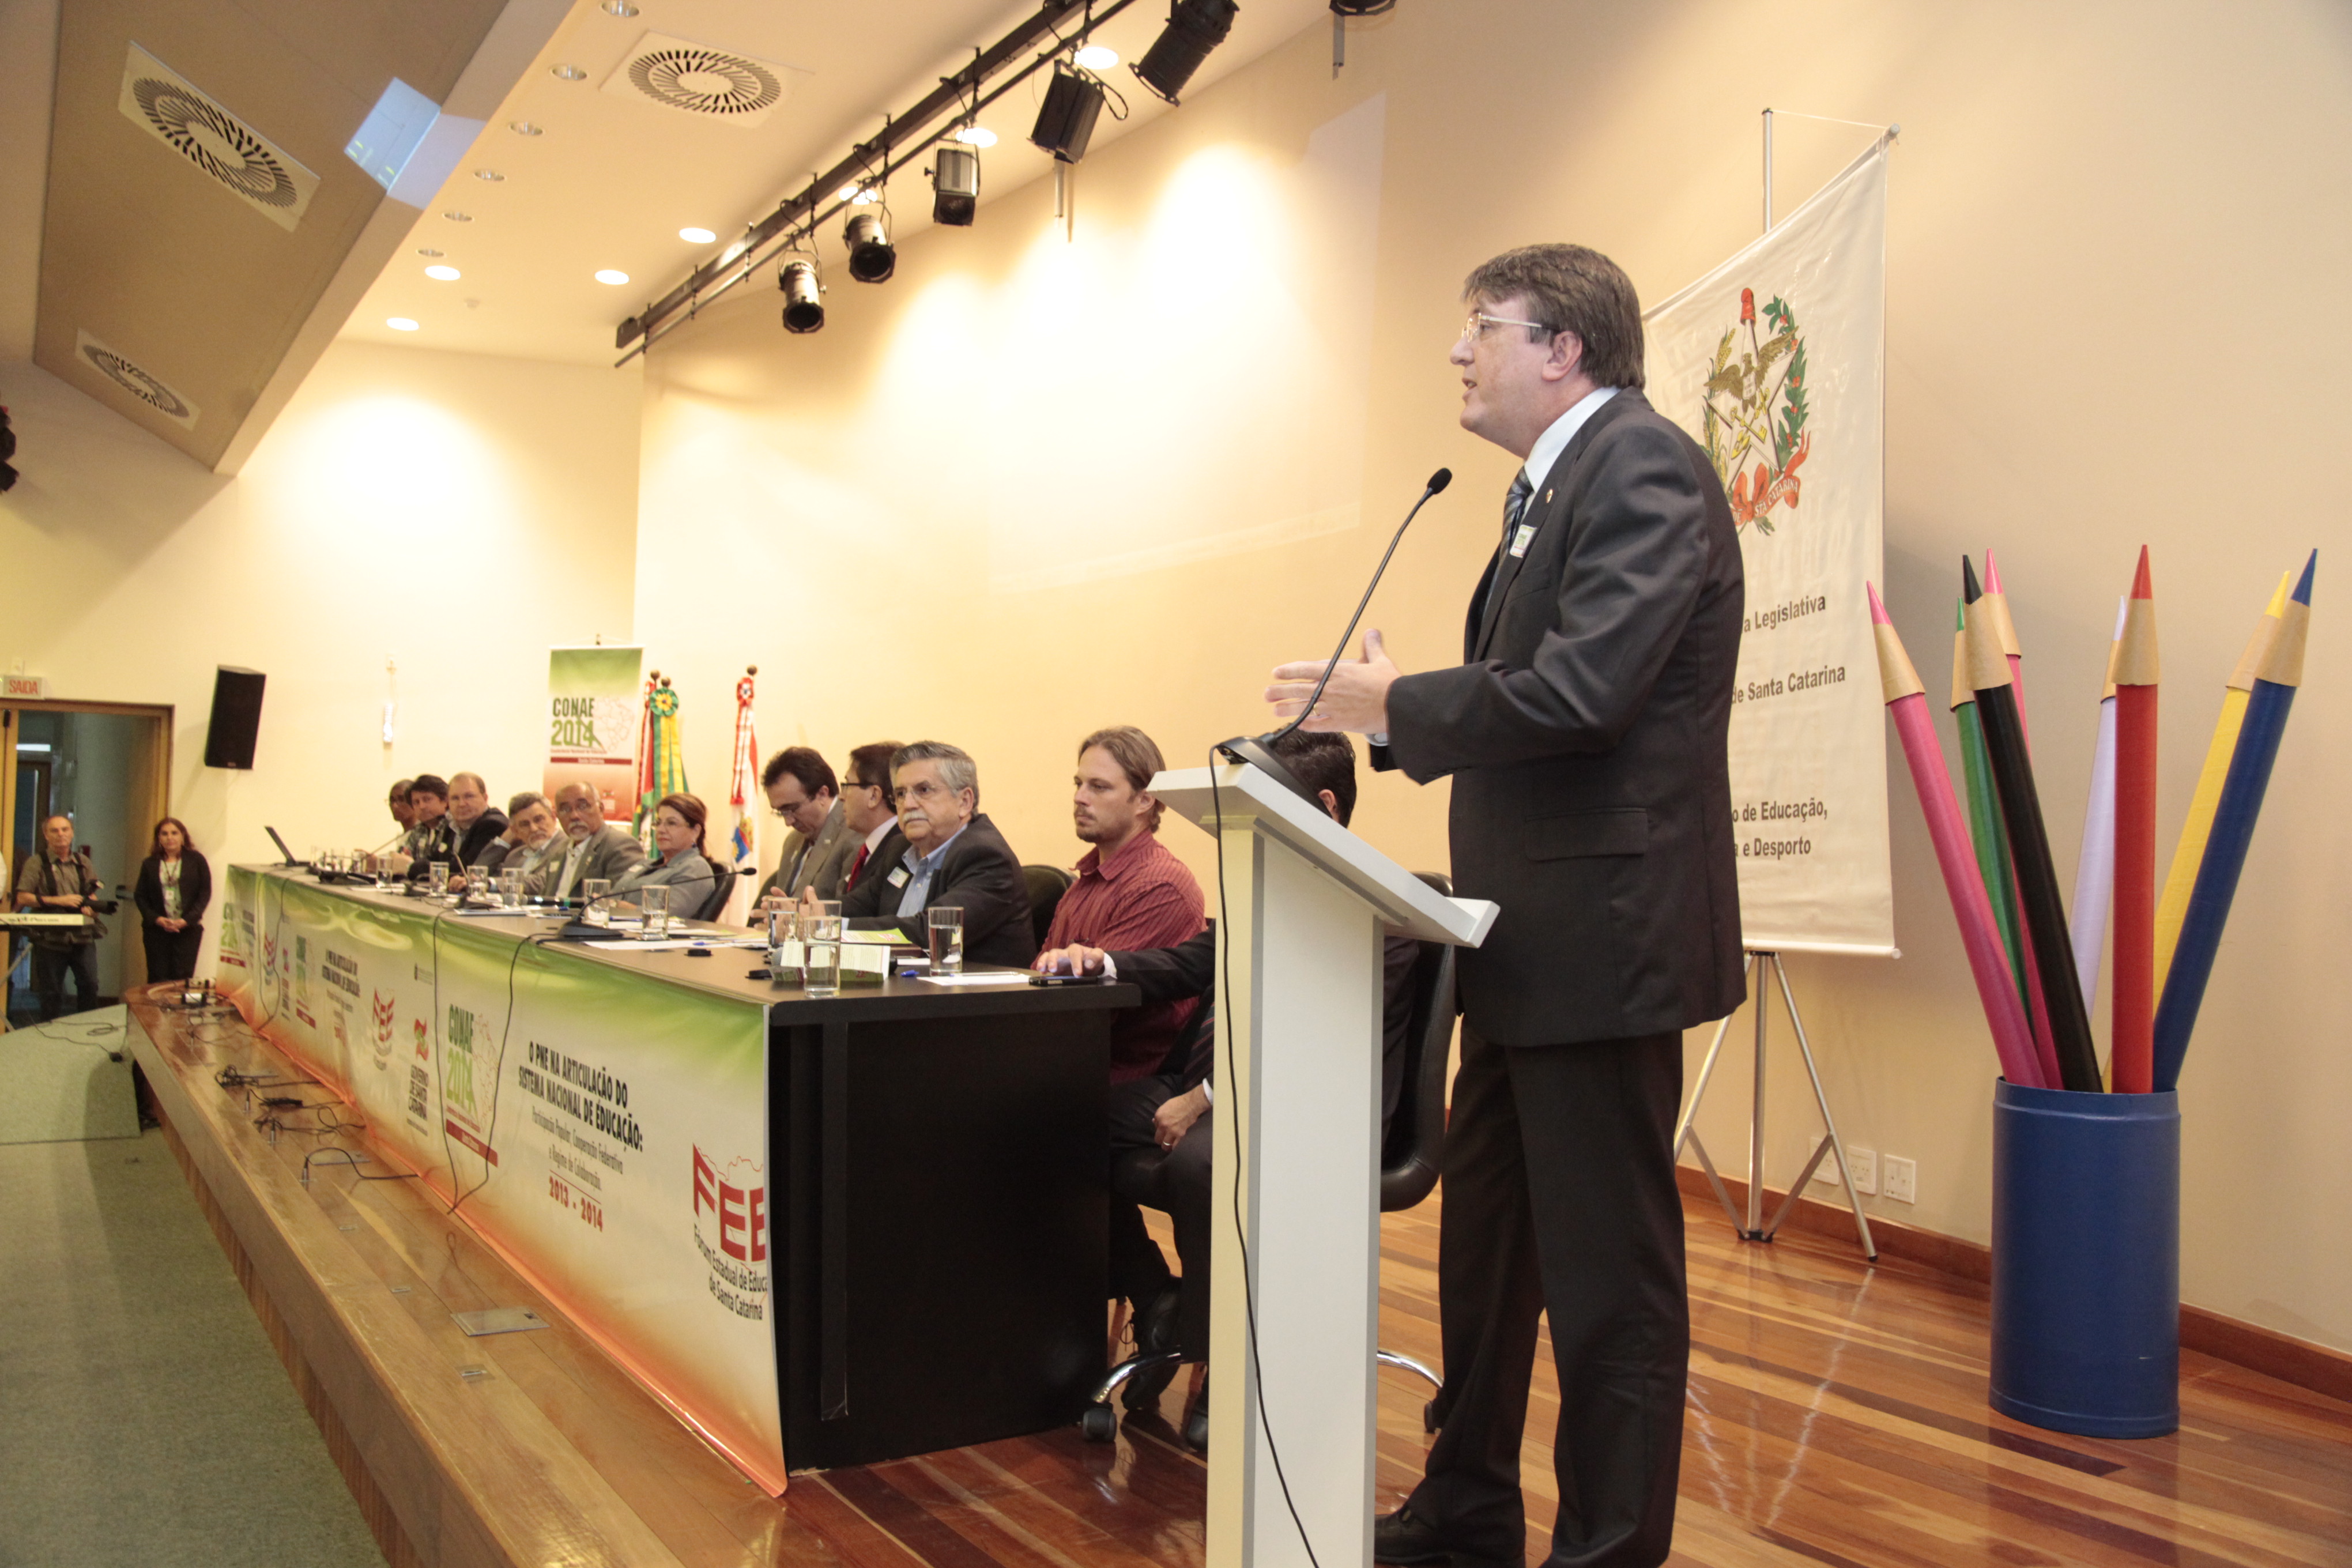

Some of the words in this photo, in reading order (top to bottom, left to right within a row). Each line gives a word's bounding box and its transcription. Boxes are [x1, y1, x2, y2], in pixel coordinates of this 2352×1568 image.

[1768, 478, 1798, 506] CATARINA
[1755, 595, 1826, 630] Legislativa
[1748, 678, 1784, 701] Santa
[1788, 665, 1845, 692] Catarina
[552, 698, 595, 718] CONAE
[551, 719, 594, 747] 2014
[1743, 803, 1757, 822] de
[1761, 797, 1827, 823] Educação,
[1743, 843, 1750, 857] e
[1754, 836, 1811, 861] Desporto
[529, 1040, 534, 1064] O
[536, 1043, 548, 1071] PNE
[551, 1049, 560, 1077] NA
[562, 1056, 613, 1103] ARTICULAÇÃO
[616, 1079, 628, 1109] DO
[519, 1065, 545, 1100] SISTEMA
[546, 1078, 582, 1120] NACIONAL
[584, 1097, 593, 1126] DE
[596, 1102, 643, 1152] EDUCAÇÃO:
[549, 1175, 569, 1208] 2013
[581, 1197, 603, 1232] 2014
[712, 1249, 738, 1288] Estadual
[738, 1267, 747, 1291] de
[709, 1271, 716, 1296] de
[717, 1280, 734, 1312] Santa
[735, 1294, 763, 1321] Catarina
